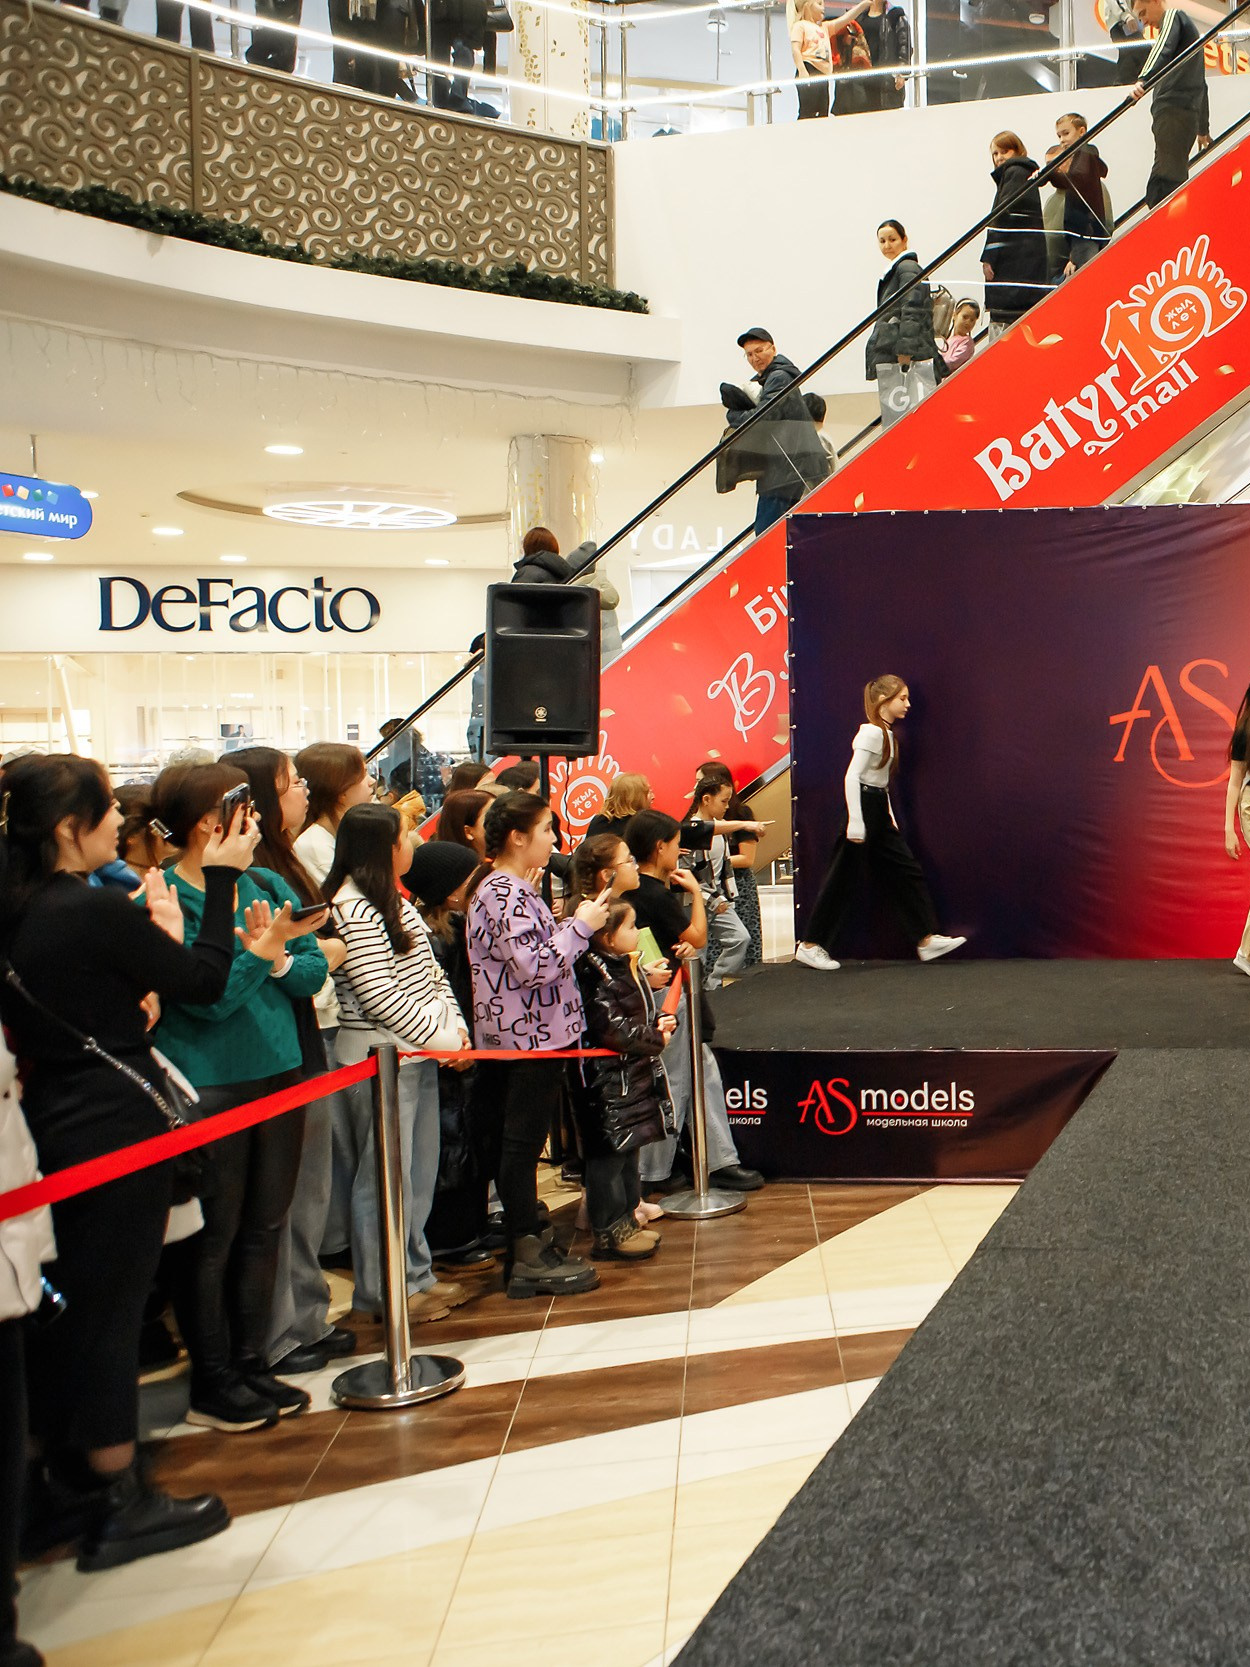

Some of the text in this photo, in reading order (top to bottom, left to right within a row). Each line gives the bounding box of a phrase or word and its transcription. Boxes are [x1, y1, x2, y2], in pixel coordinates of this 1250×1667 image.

[1120, 358, 1200, 430] mall
[973, 363, 1128, 501] Batyr
[48, 511, 78, 530] мир
[98, 576, 381, 633] DeFacto
[725, 1080, 768, 1109] els
[797, 1077, 975, 1135] AS models
[866, 1117, 968, 1129] модельная школа
